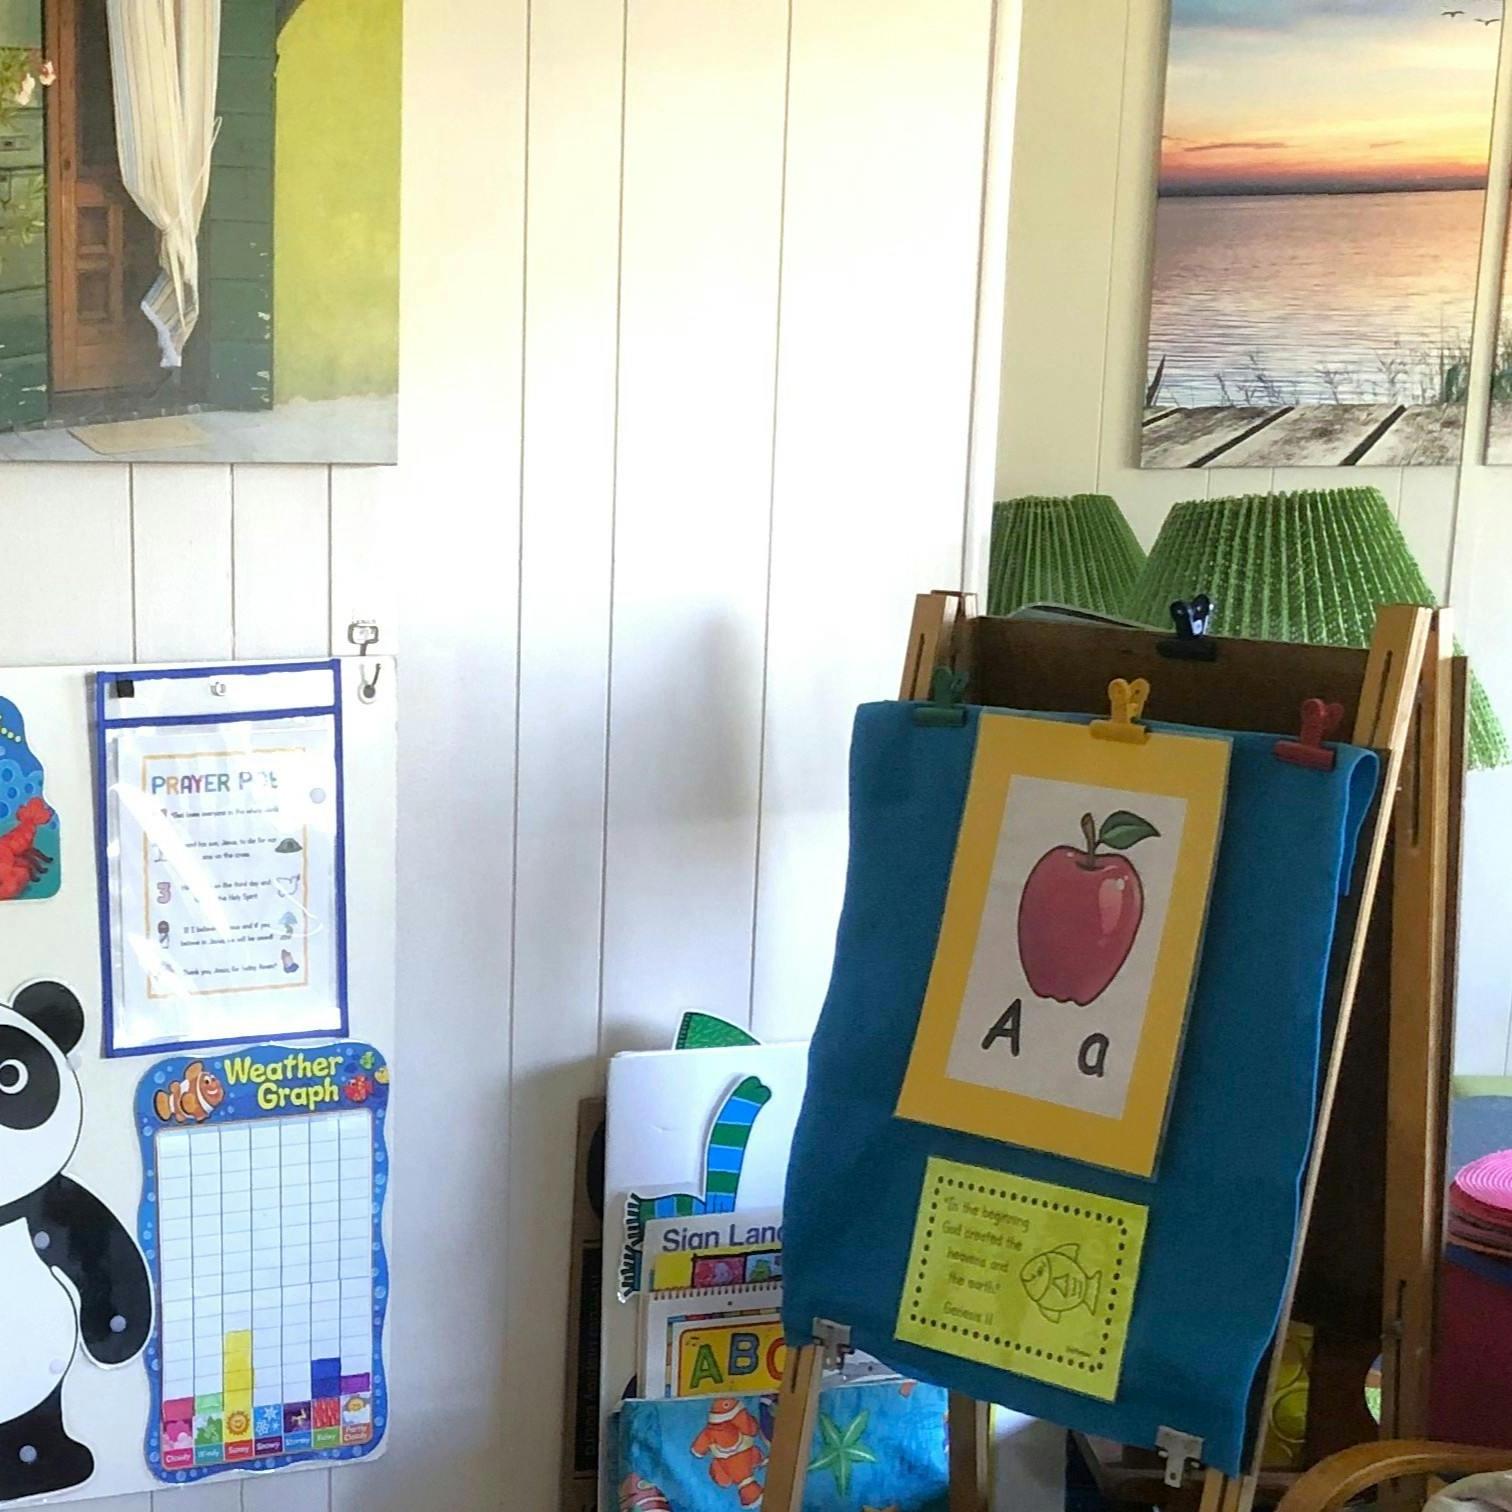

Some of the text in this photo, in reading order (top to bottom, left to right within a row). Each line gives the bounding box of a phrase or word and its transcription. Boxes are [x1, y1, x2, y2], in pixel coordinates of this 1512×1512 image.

[151, 773, 230, 795] PRAYER
[981, 998, 1110, 1078] A a
[223, 1054, 344, 1084] Weather
[257, 1077, 339, 1110] Graph
